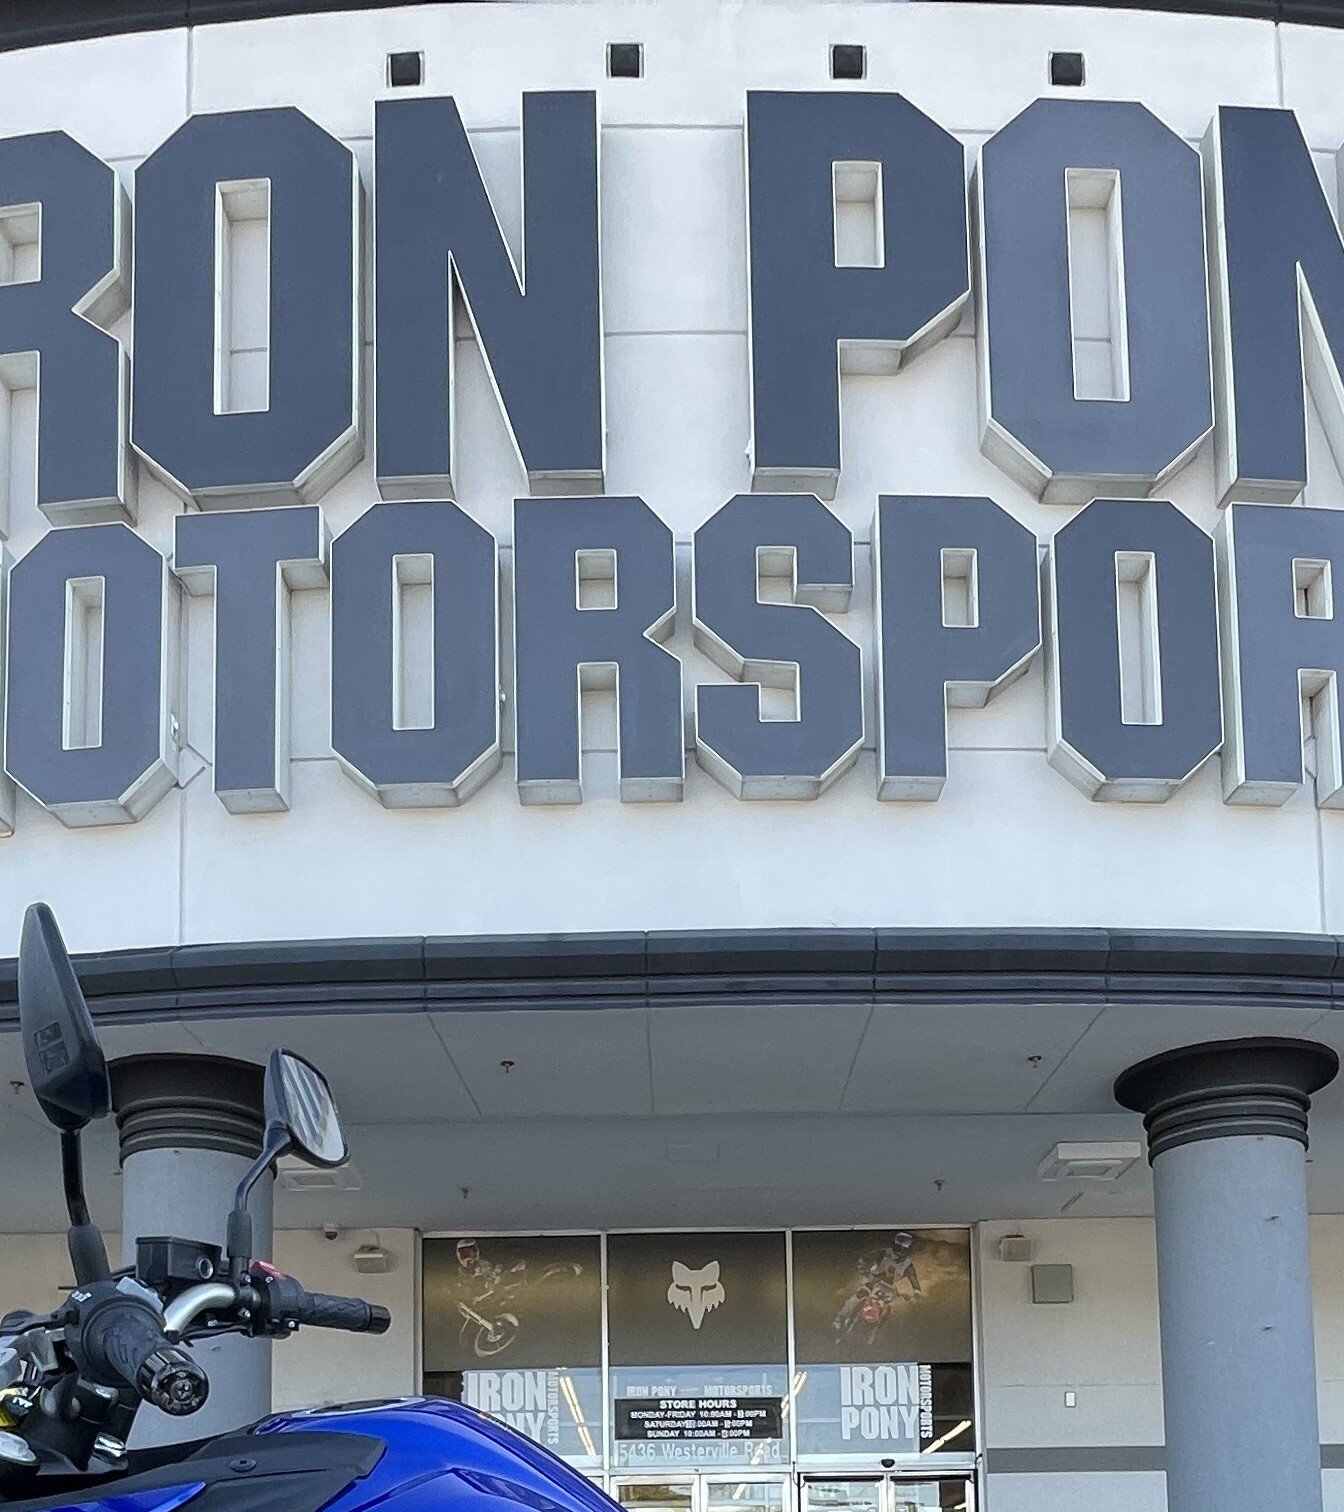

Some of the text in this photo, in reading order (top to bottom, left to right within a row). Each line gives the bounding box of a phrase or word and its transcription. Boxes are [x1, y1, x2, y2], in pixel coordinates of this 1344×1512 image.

[467, 1371, 547, 1412] IRON
[626, 1384, 773, 1397] IRON PONY MOTORSPORTS
[840, 1366, 919, 1406] IRON
[919, 1364, 934, 1440] MOTORSPORTS
[547, 1370, 560, 1445] MOTORSPORTS
[659, 1399, 737, 1410] STORE HOURS
[647, 1429, 680, 1438] SUNDAY
[841, 1406, 919, 1440] PONY
[619, 1441, 780, 1463] 5436 Westerville Rad
